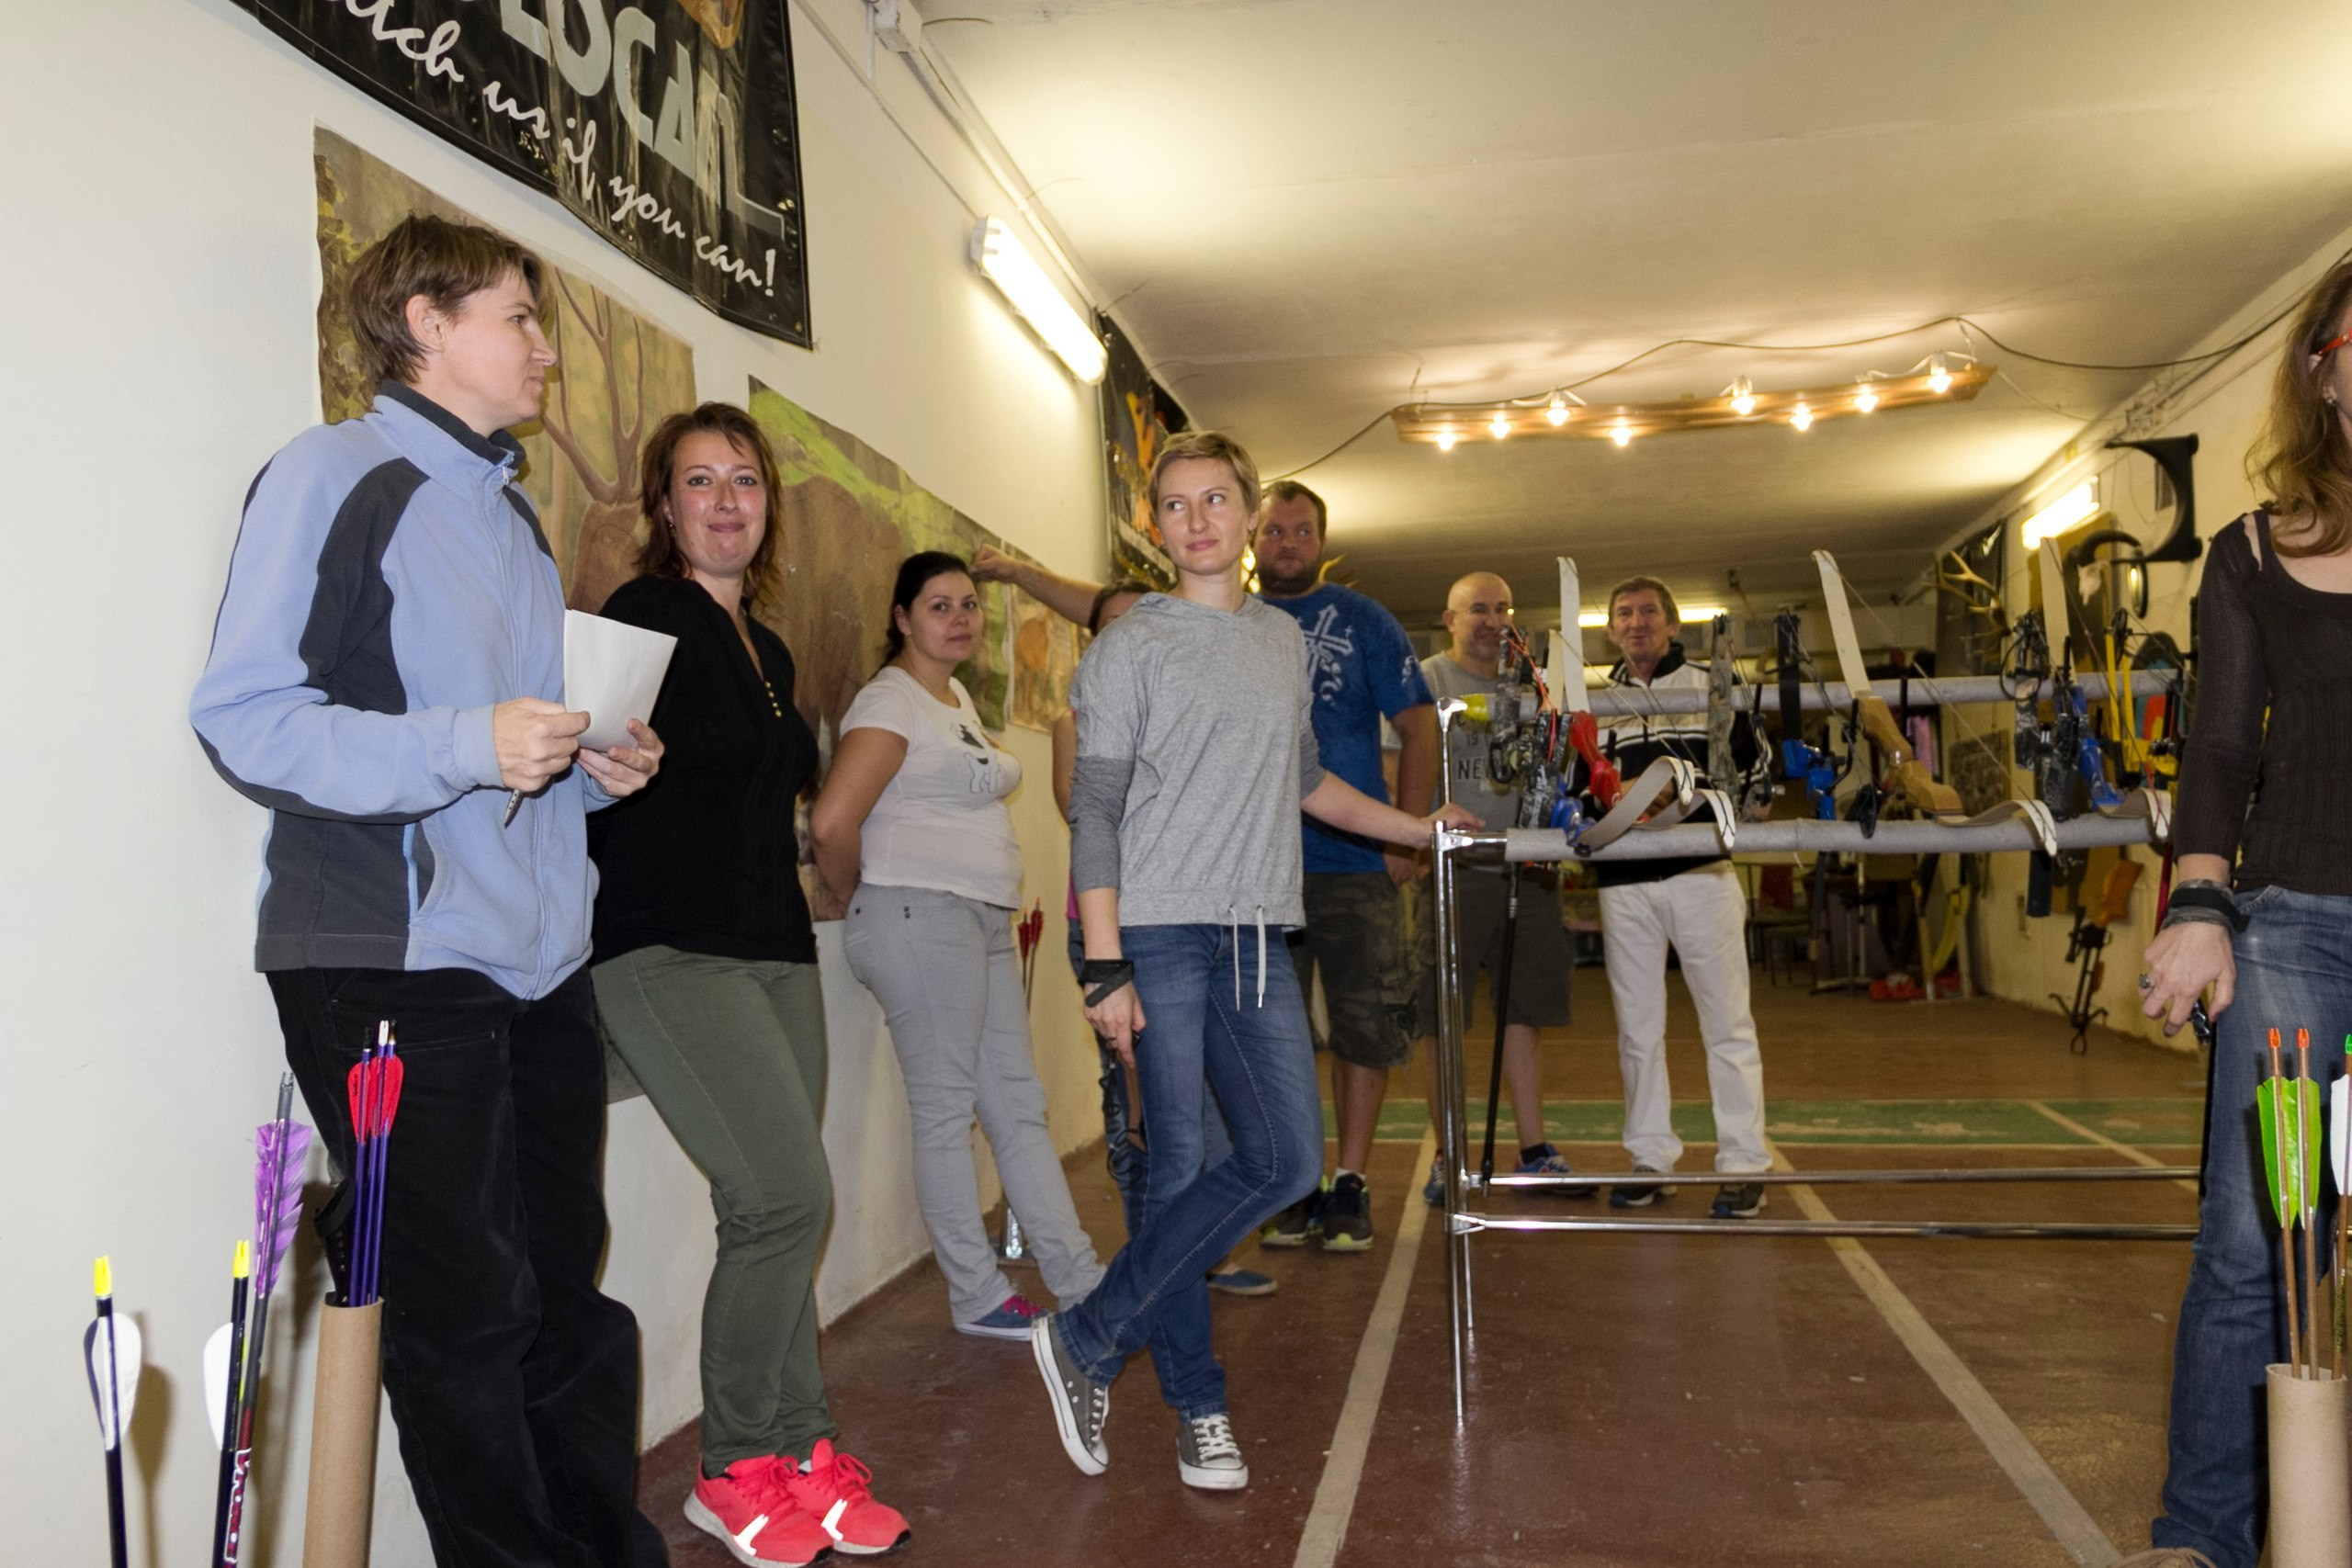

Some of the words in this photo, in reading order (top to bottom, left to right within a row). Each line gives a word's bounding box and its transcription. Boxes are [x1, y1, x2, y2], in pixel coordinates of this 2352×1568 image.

[328, 0, 465, 83] tch
[483, 81, 550, 140] us
[562, 118, 597, 201] if
[608, 175, 685, 239] you
[695, 235, 776, 297] can!
